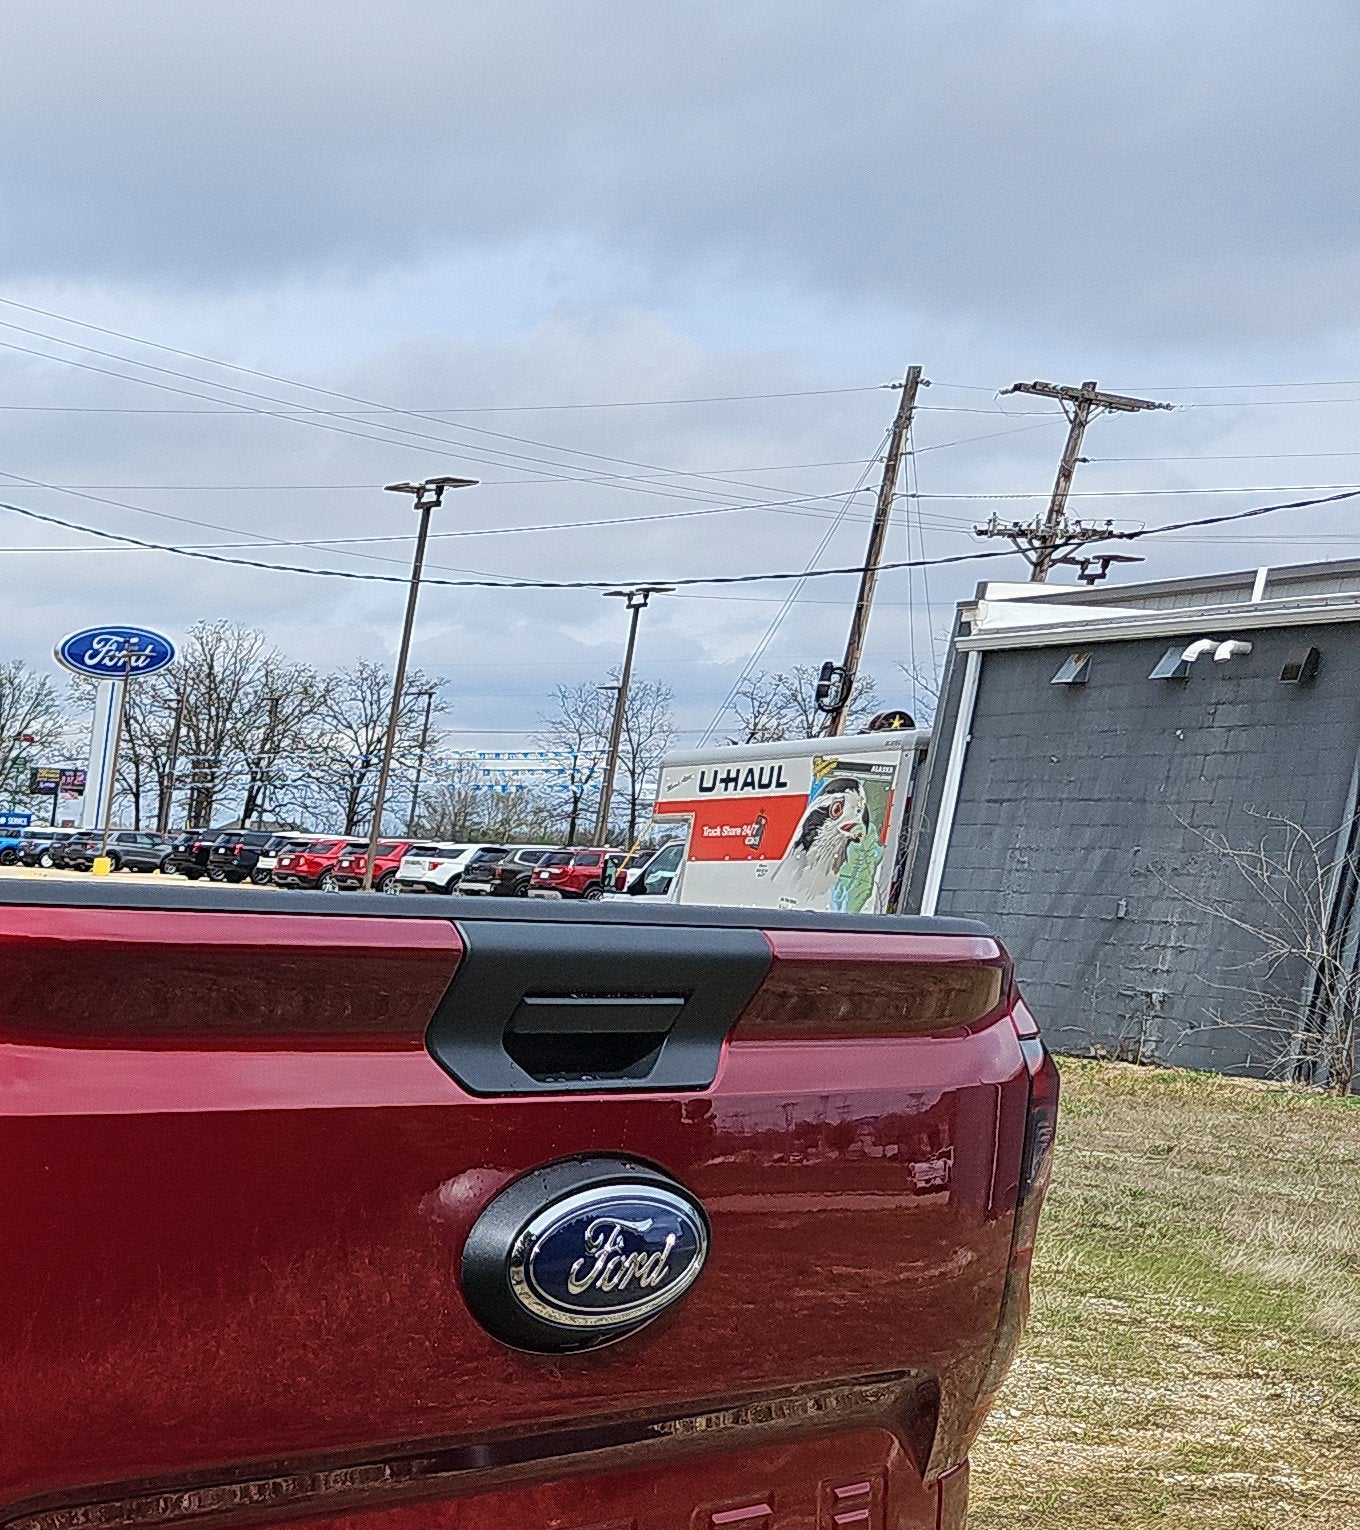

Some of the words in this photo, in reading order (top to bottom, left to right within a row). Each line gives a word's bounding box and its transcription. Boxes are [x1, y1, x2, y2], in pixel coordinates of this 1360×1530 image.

[83, 634, 158, 667] Ford
[698, 764, 788, 793] U-HAUL
[702, 825, 721, 837] Truck
[721, 825, 741, 836] Share
[567, 1217, 677, 1295] Ford
